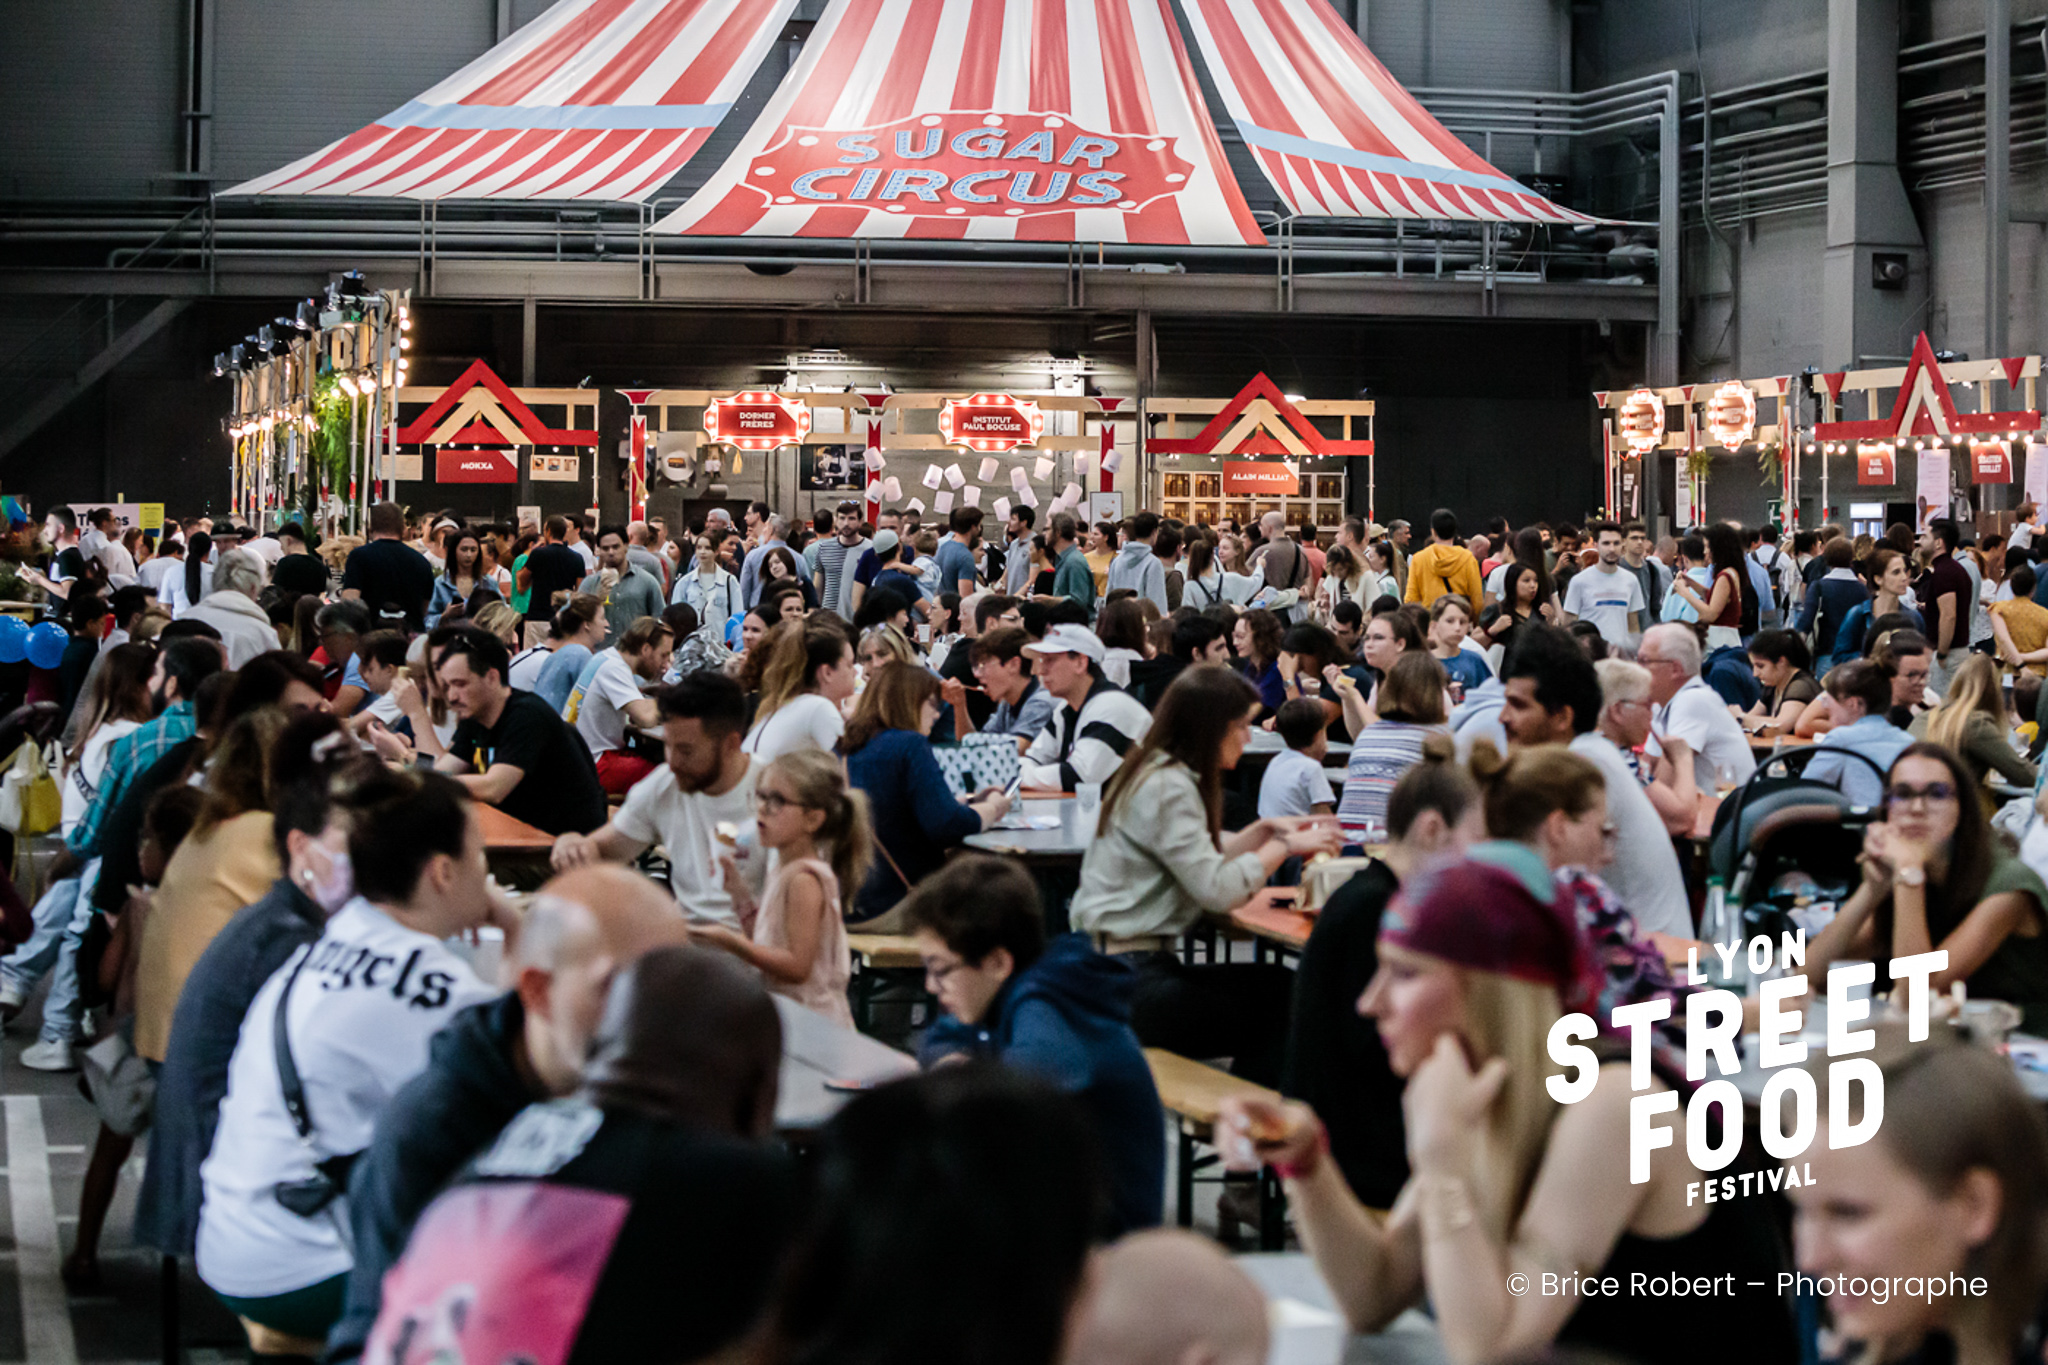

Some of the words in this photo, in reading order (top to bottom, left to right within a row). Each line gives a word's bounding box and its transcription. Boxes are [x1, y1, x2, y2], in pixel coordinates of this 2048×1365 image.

[837, 127, 1119, 169] SUGAR
[791, 167, 1126, 204] CIRCUS
[739, 411, 776, 421] DORNER
[972, 415, 1012, 424] INSTITUT
[962, 423, 985, 431] PAUL
[986, 423, 1022, 432] BOCUSE
[460, 461, 494, 471] MOKXA
[1231, 472, 1257, 482] ALAIN
[1258, 473, 1290, 482] MILLIAT
